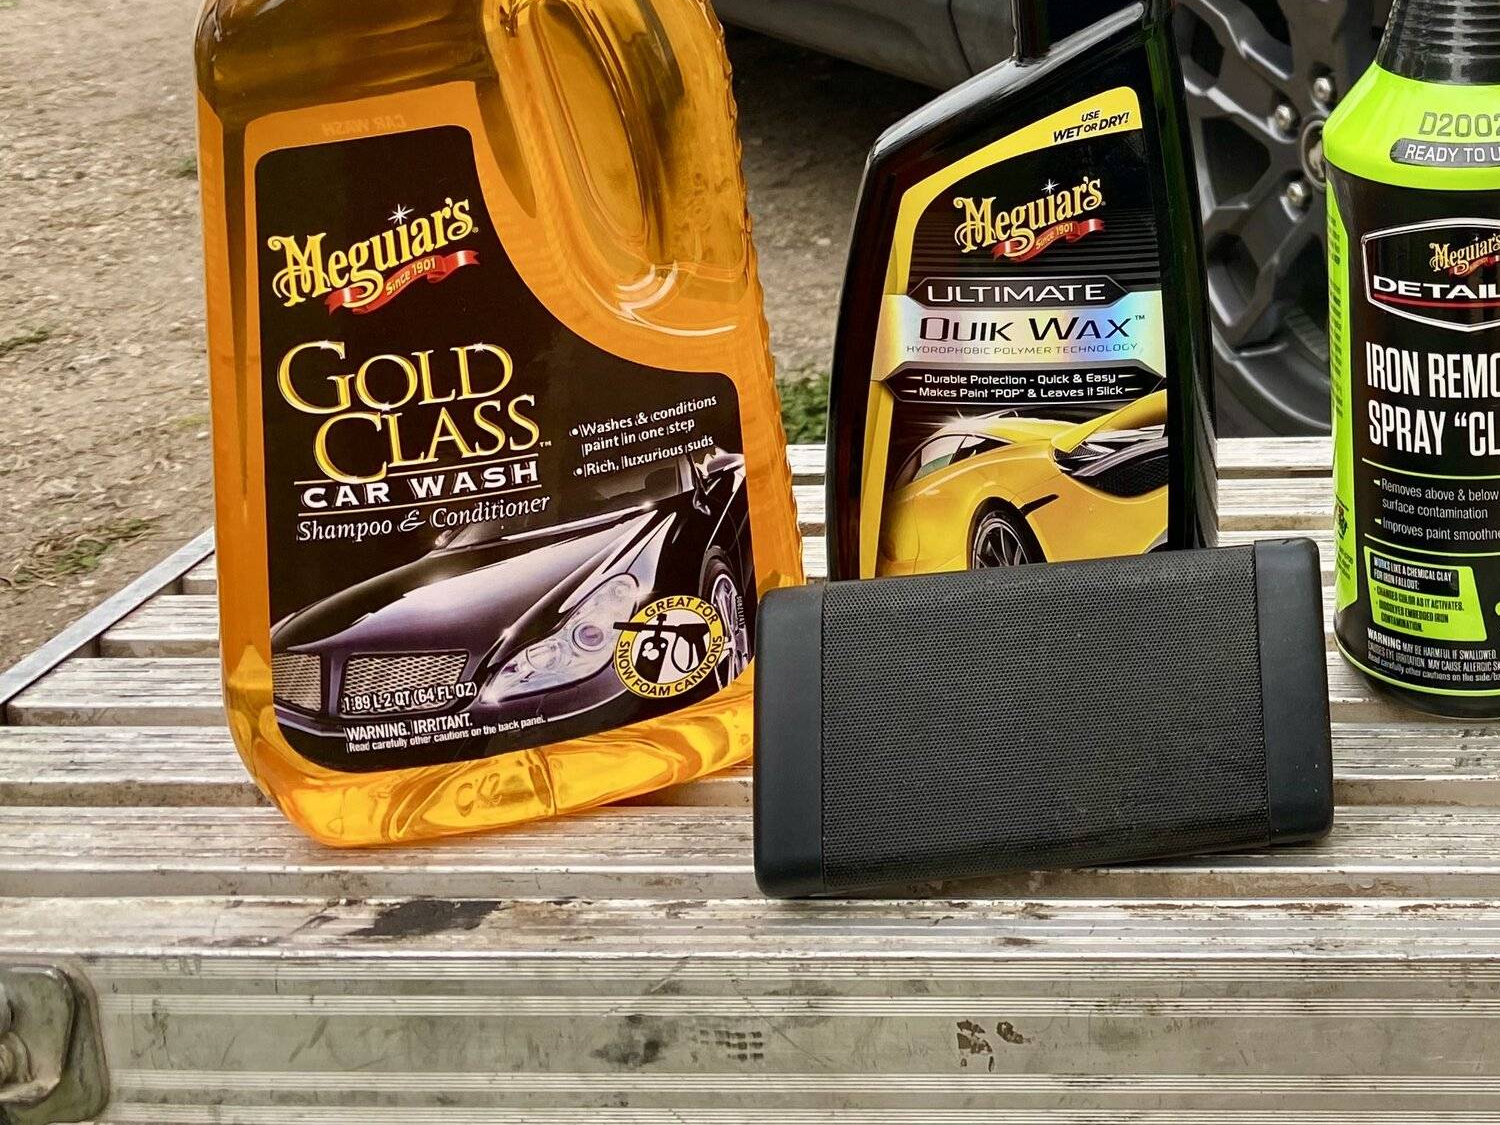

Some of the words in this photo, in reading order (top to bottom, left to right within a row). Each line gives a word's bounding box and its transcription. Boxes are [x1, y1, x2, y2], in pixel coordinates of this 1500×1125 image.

[1053, 124, 1083, 142] WET
[1084, 124, 1097, 133] OR
[1099, 112, 1129, 130] DRY!
[1082, 110, 1100, 122] USE
[1405, 145, 1458, 161] READY
[1464, 147, 1485, 162] TO
[953, 176, 1102, 257] Meguiar's
[1036, 231, 1054, 249] Since
[1056, 223, 1073, 236] 1901
[268, 197, 473, 307] Meguiar's
[387, 273, 410, 296] Since
[412, 258, 436, 277] 1901
[927, 284, 1105, 302] ULTIMATE
[920, 317, 1014, 342] QUIK
[1028, 317, 1131, 341] WAX
[907, 346, 990, 354] HYDROPHOBIC
[994, 346, 1051, 355] POLYMER
[1056, 343, 1137, 353] TECHNOLOGY
[277, 340, 513, 414] GOLD
[924, 374, 967, 384] Durable
[971, 375, 1026, 384] Protection
[1038, 375, 1069, 384] Quick
[1086, 374, 1115, 383] Easy
[1366, 341, 1420, 397] IRON
[919, 388, 956, 398] Makes
[960, 389, 988, 398] Paint
[1041, 388, 1083, 398] Leaves
[1097, 386, 1123, 396] Slick
[581, 416, 632, 437] Washes
[652, 396, 717, 421] conditions
[1368, 401, 1446, 456] SPRAY
[313, 394, 540, 484] CLASS
[585, 433, 620, 455] paint
[641, 427, 664, 440] one
[670, 419, 695, 433] step
[586, 459, 619, 476] Rich,
[624, 445, 683, 467] luxurious
[688, 435, 714, 451] suds
[302, 482, 391, 507] CAR
[408, 460, 538, 499] WASH
[1381, 478, 1422, 497] Removes
[1425, 488, 1454, 501] above
[1458, 489, 1465, 501] &
[1469, 489, 1499, 501] below
[298, 518, 392, 542] Shampoo
[398, 510, 425, 532] &
[431, 495, 550, 527] Conditioner
[1383, 498, 1414, 514] surface
[1418, 506, 1488, 519] contamination
[1383, 517, 1423, 537] Improves
[1426, 528, 1450, 540] paint
[645, 597, 694, 617] GREAT
[696, 601, 718, 625] FOR
[1367, 628, 1401, 650] WARNING
[619, 641, 634, 680] SNOW
[632, 679, 670, 695] FOAM
[675, 636, 722, 693] CANNONS
[346, 723, 410, 741] WARNING.
[414, 713, 473, 734] IRRITANT.
